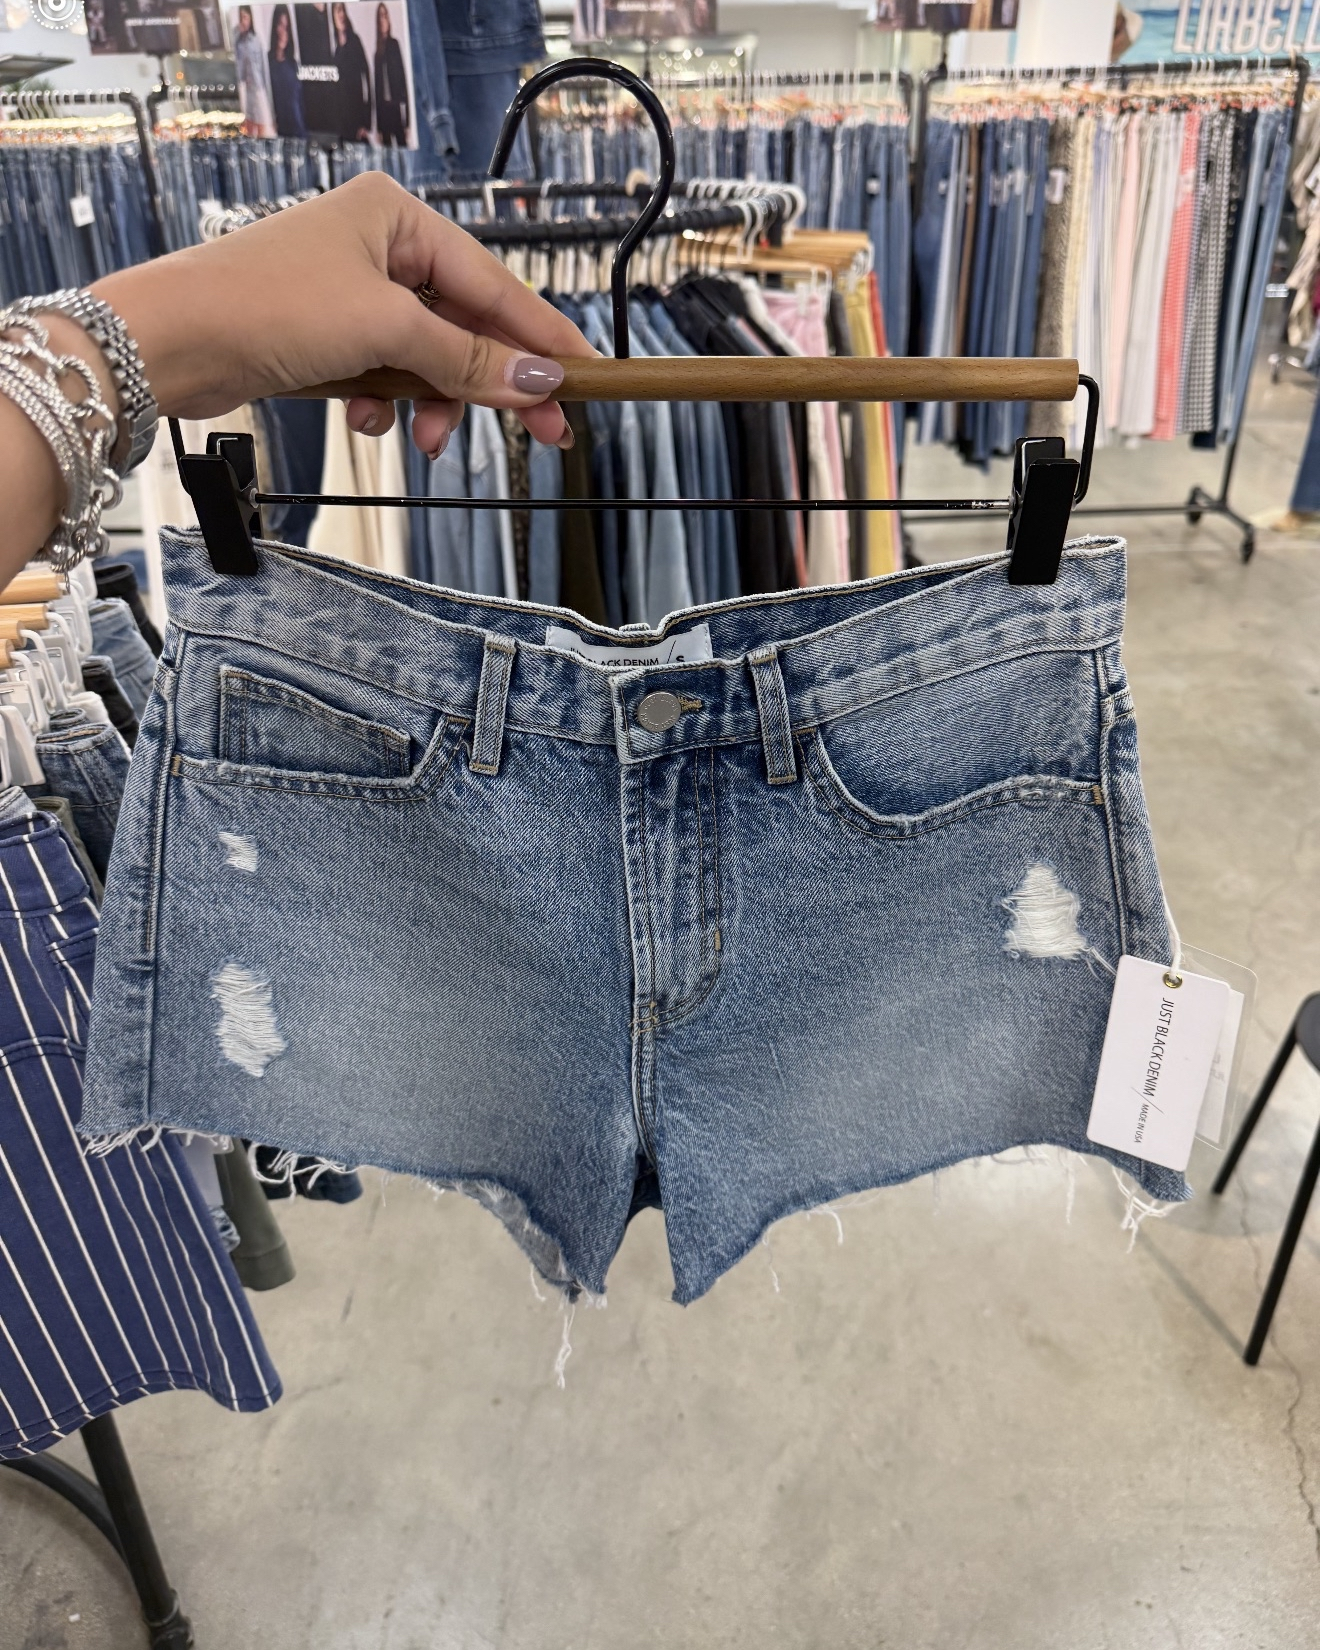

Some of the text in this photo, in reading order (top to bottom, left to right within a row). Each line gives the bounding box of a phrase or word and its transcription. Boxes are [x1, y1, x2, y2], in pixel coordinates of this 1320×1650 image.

[297, 65, 340, 82] JACKETS
[1142, 997, 1174, 1096] JUST BLACK DENIM
[1133, 1103, 1150, 1144] MADE IN USA
